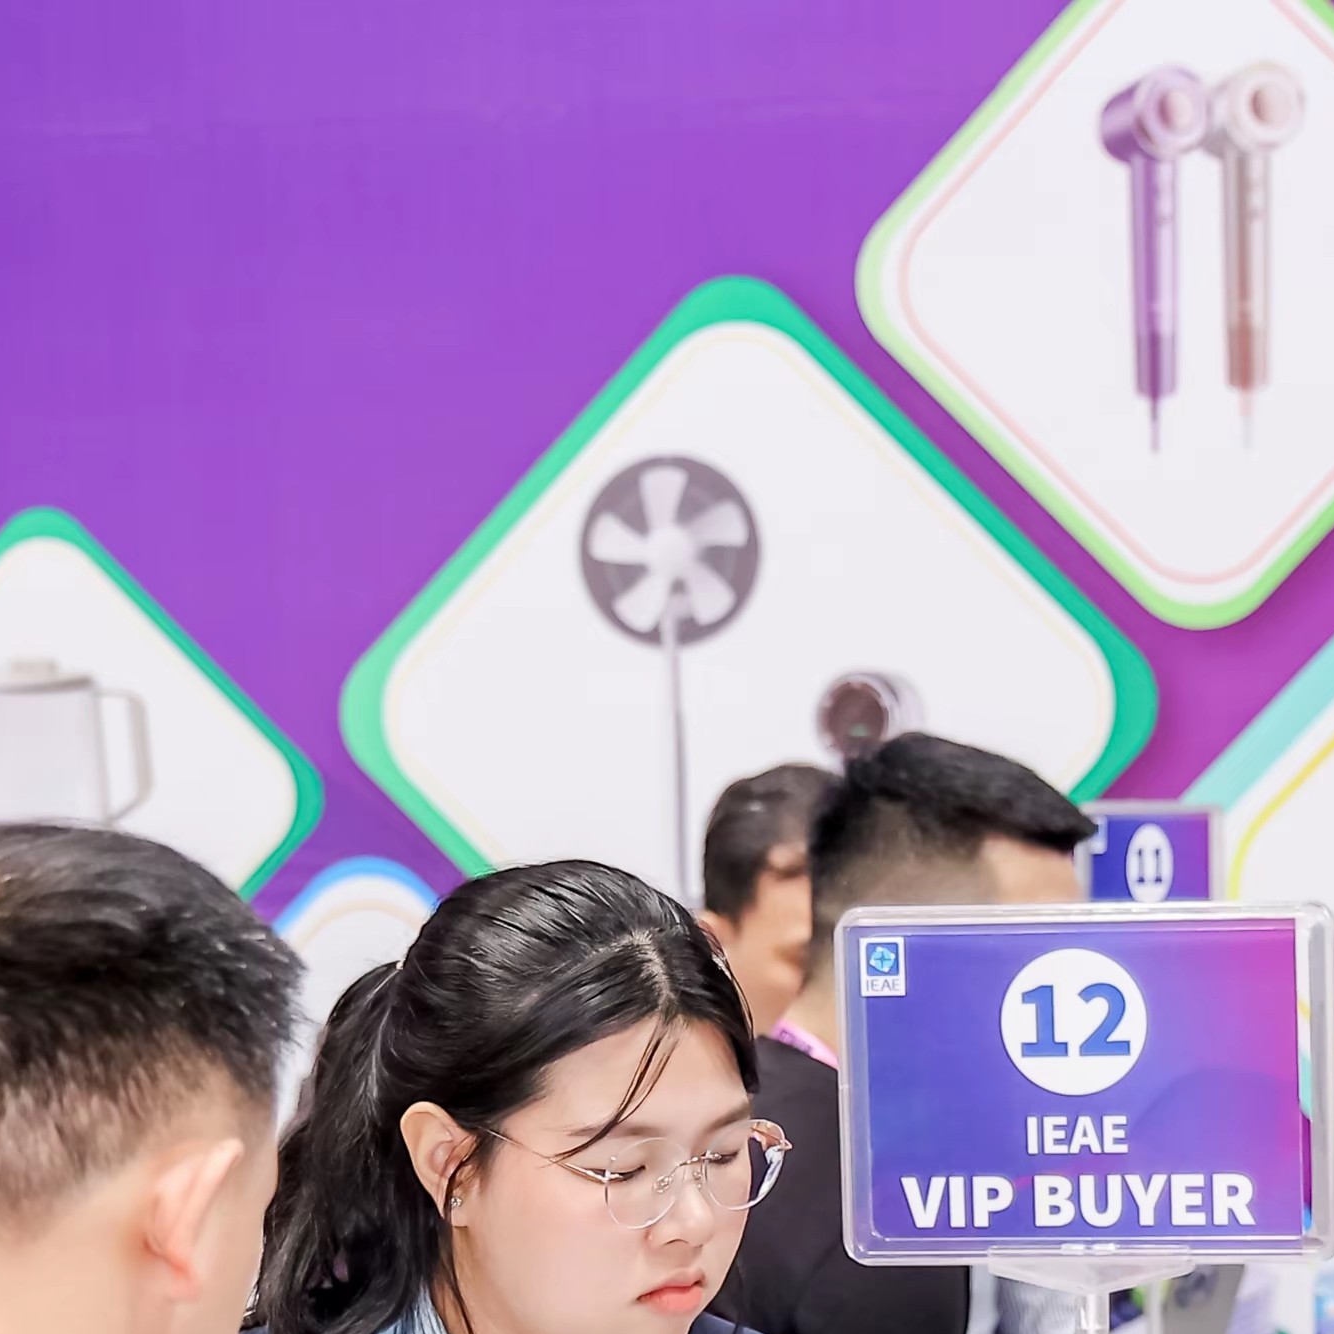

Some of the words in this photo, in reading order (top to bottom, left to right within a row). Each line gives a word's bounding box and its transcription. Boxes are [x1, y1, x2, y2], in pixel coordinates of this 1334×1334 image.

[1135, 847, 1164, 885] 11
[865, 978, 901, 993] IEAE
[1019, 982, 1132, 1058] 12
[1025, 1114, 1129, 1156] IEAE
[901, 1174, 1015, 1230] VIP
[1033, 1171, 1256, 1228] BUYER
